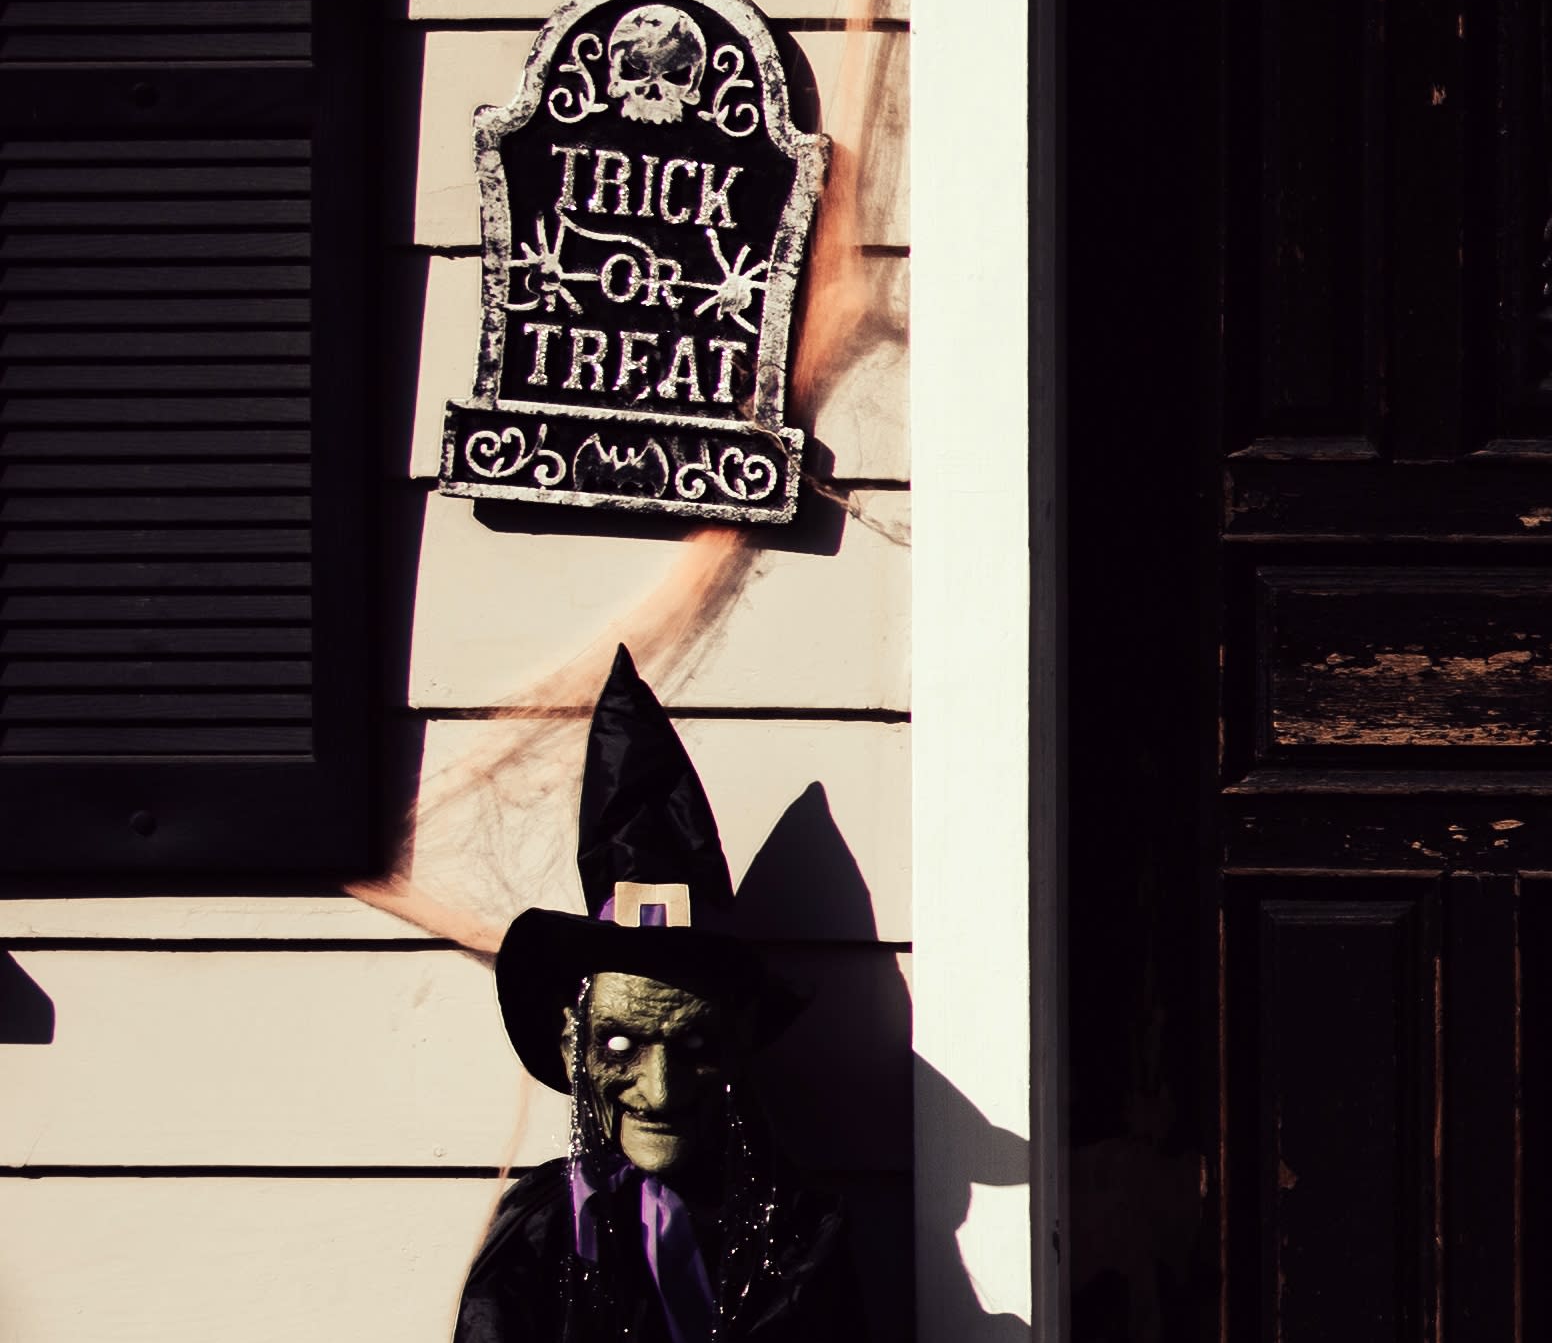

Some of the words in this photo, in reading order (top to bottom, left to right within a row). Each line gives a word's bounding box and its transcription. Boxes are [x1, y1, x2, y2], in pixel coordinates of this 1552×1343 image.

[551, 145, 744, 229] TRICK
[601, 253, 683, 307] OR
[524, 324, 751, 404] TREAT
